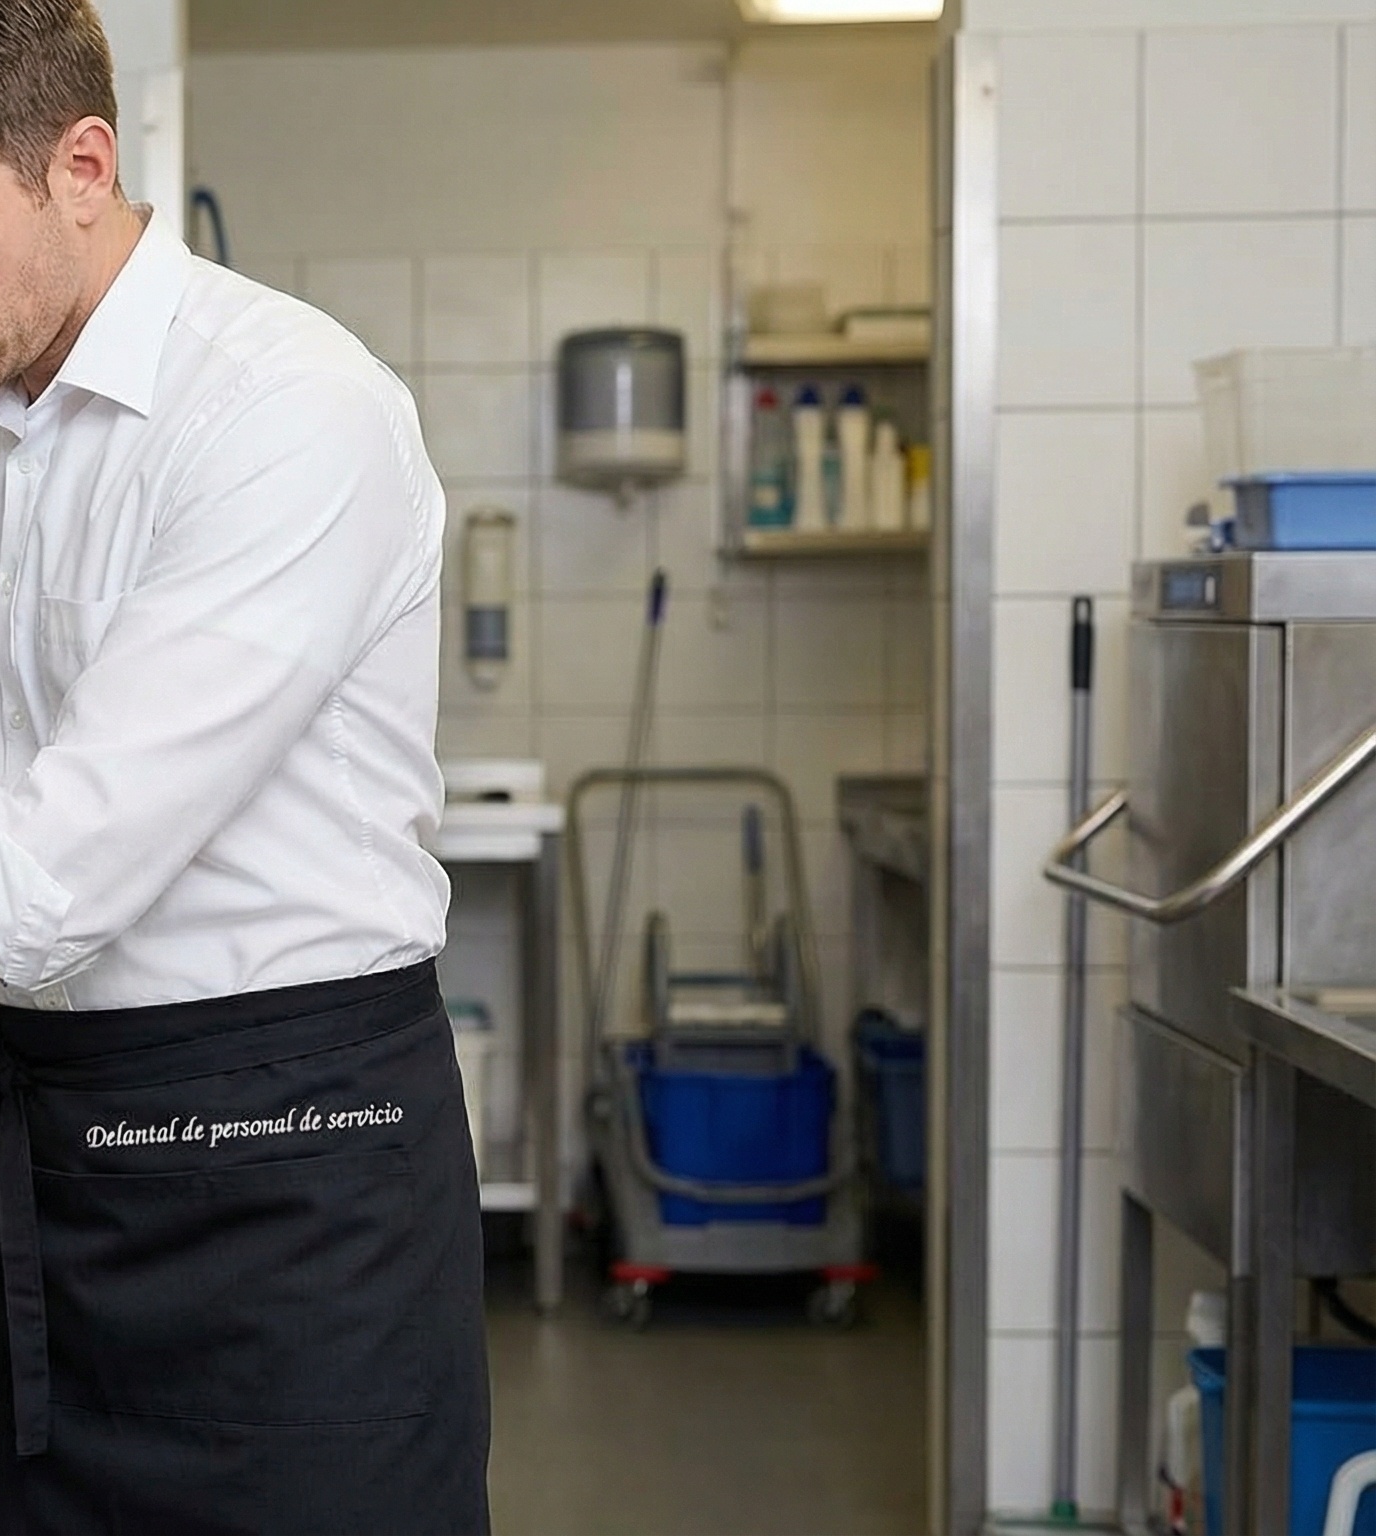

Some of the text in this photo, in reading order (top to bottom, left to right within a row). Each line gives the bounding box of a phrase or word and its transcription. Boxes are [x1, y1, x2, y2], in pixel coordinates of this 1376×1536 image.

[86, 1102, 404, 1148] Delantal de personal de servicio
